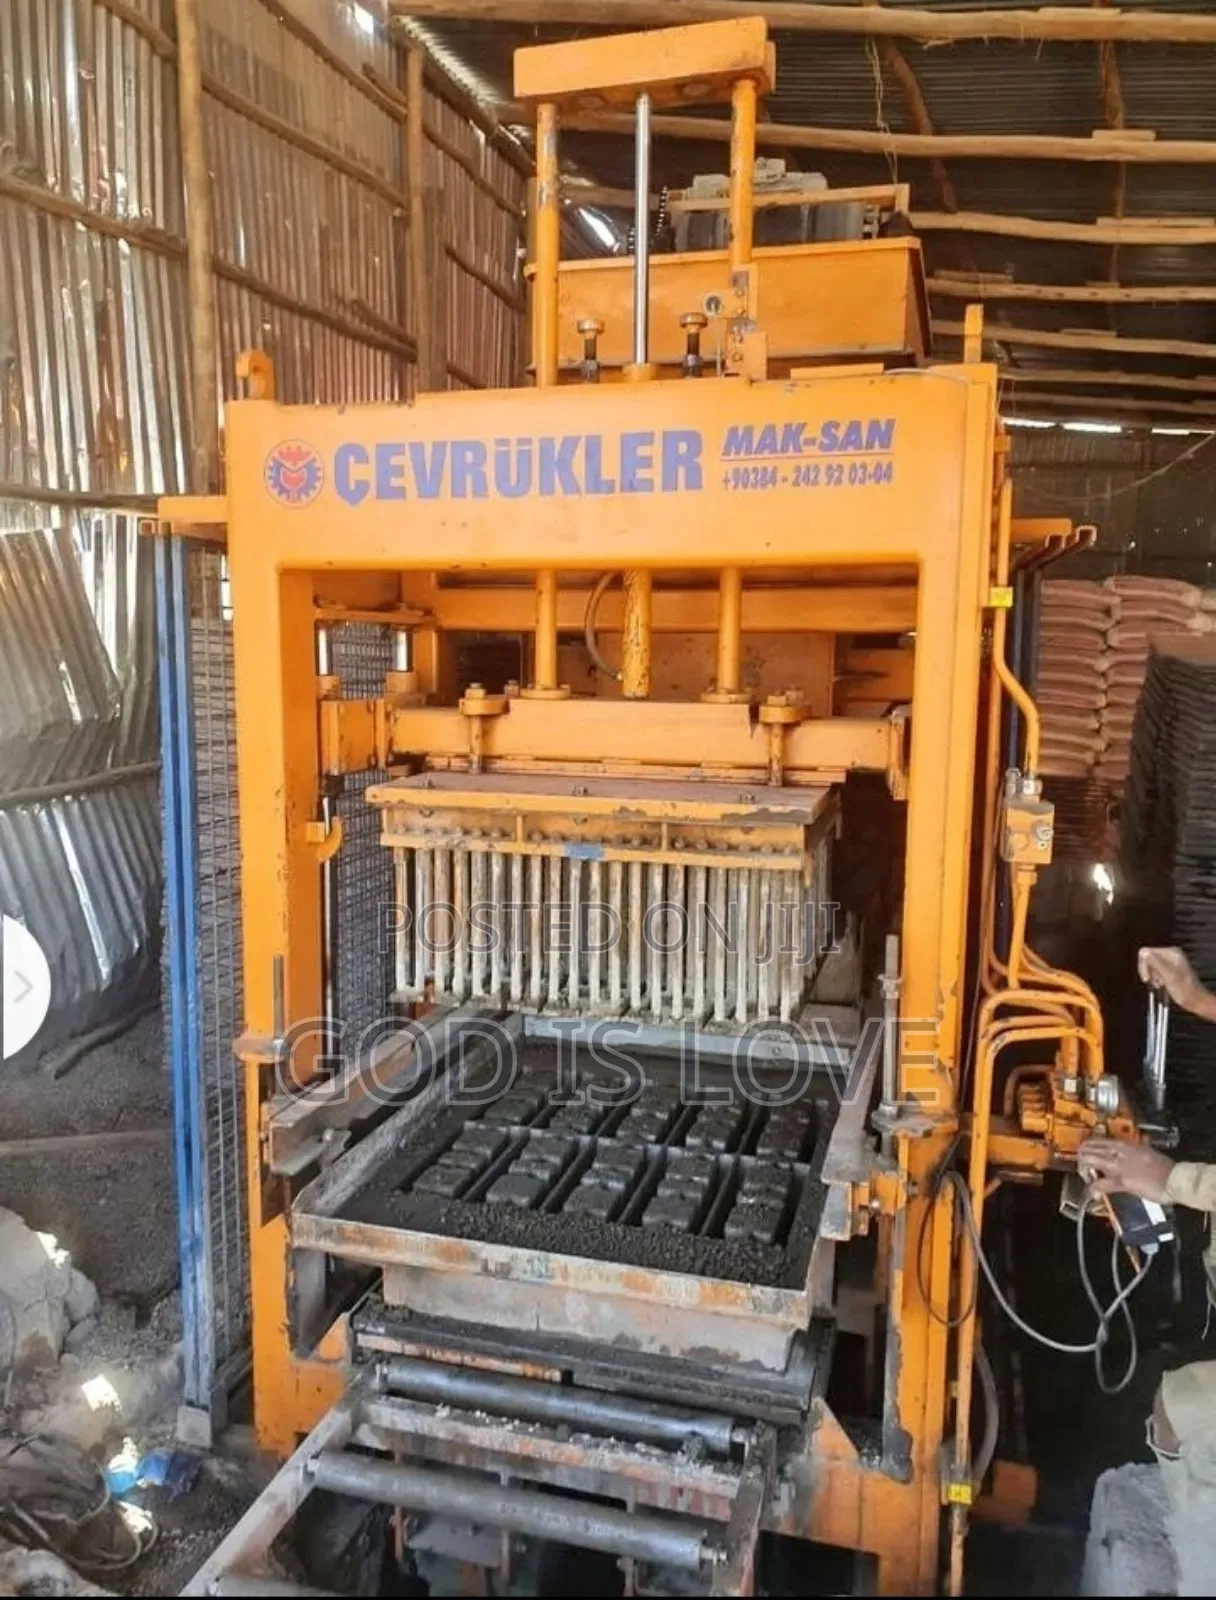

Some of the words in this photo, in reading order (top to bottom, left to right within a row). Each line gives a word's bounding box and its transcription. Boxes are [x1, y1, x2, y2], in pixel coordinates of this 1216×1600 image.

[721, 418, 896, 456] MAK-SAN
[334, 430, 704, 506] ÇEVRÜKLER
[792, 463, 820, 487] 242
[824, 462, 844, 486] 92
